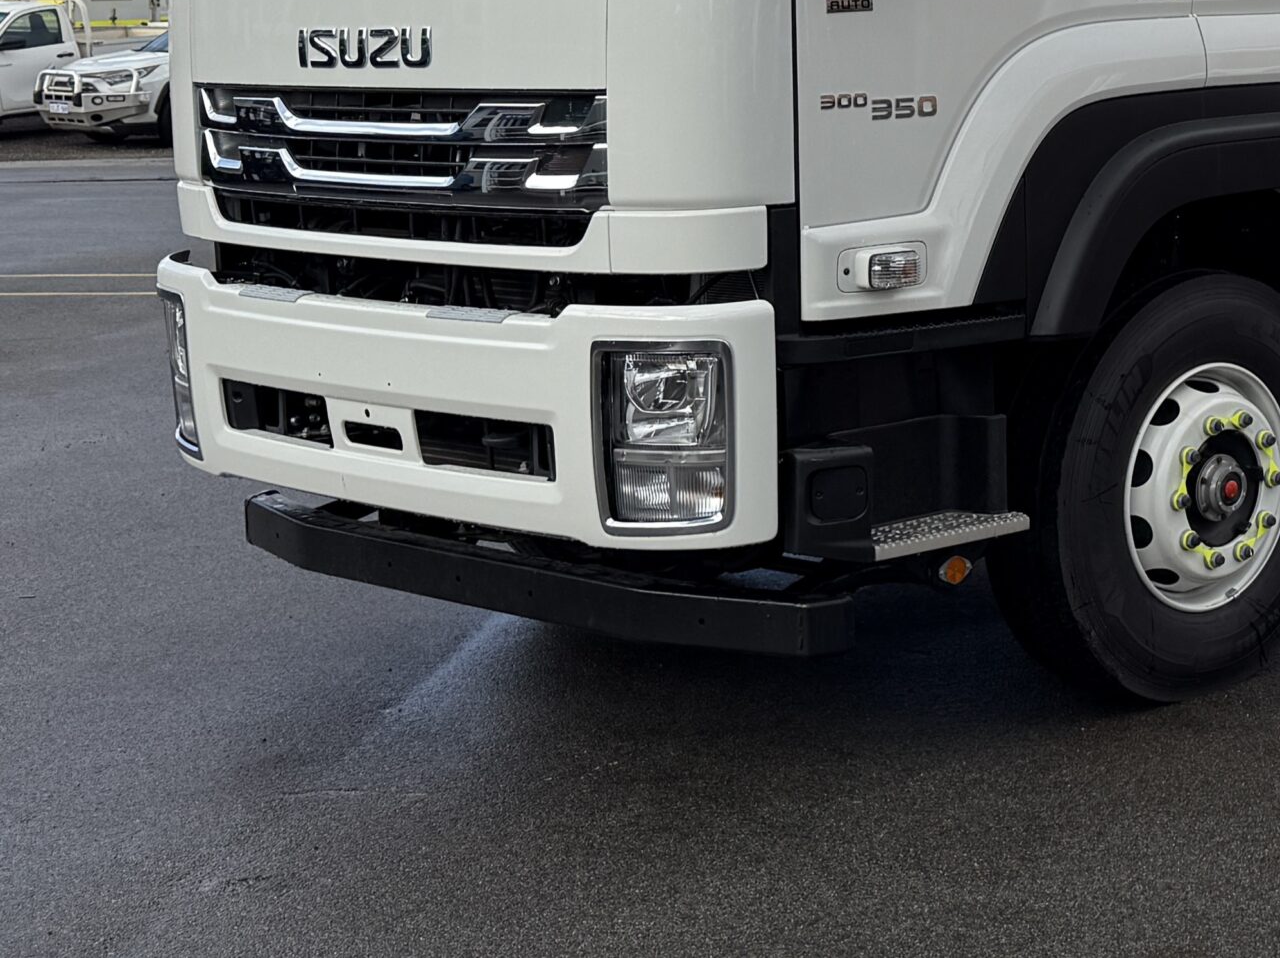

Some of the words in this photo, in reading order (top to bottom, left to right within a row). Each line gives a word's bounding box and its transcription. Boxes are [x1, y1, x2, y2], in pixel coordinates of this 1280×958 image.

[298, 26, 432, 68] ISUZU
[820, 93, 868, 110] 300
[871, 95, 937, 121] 350
